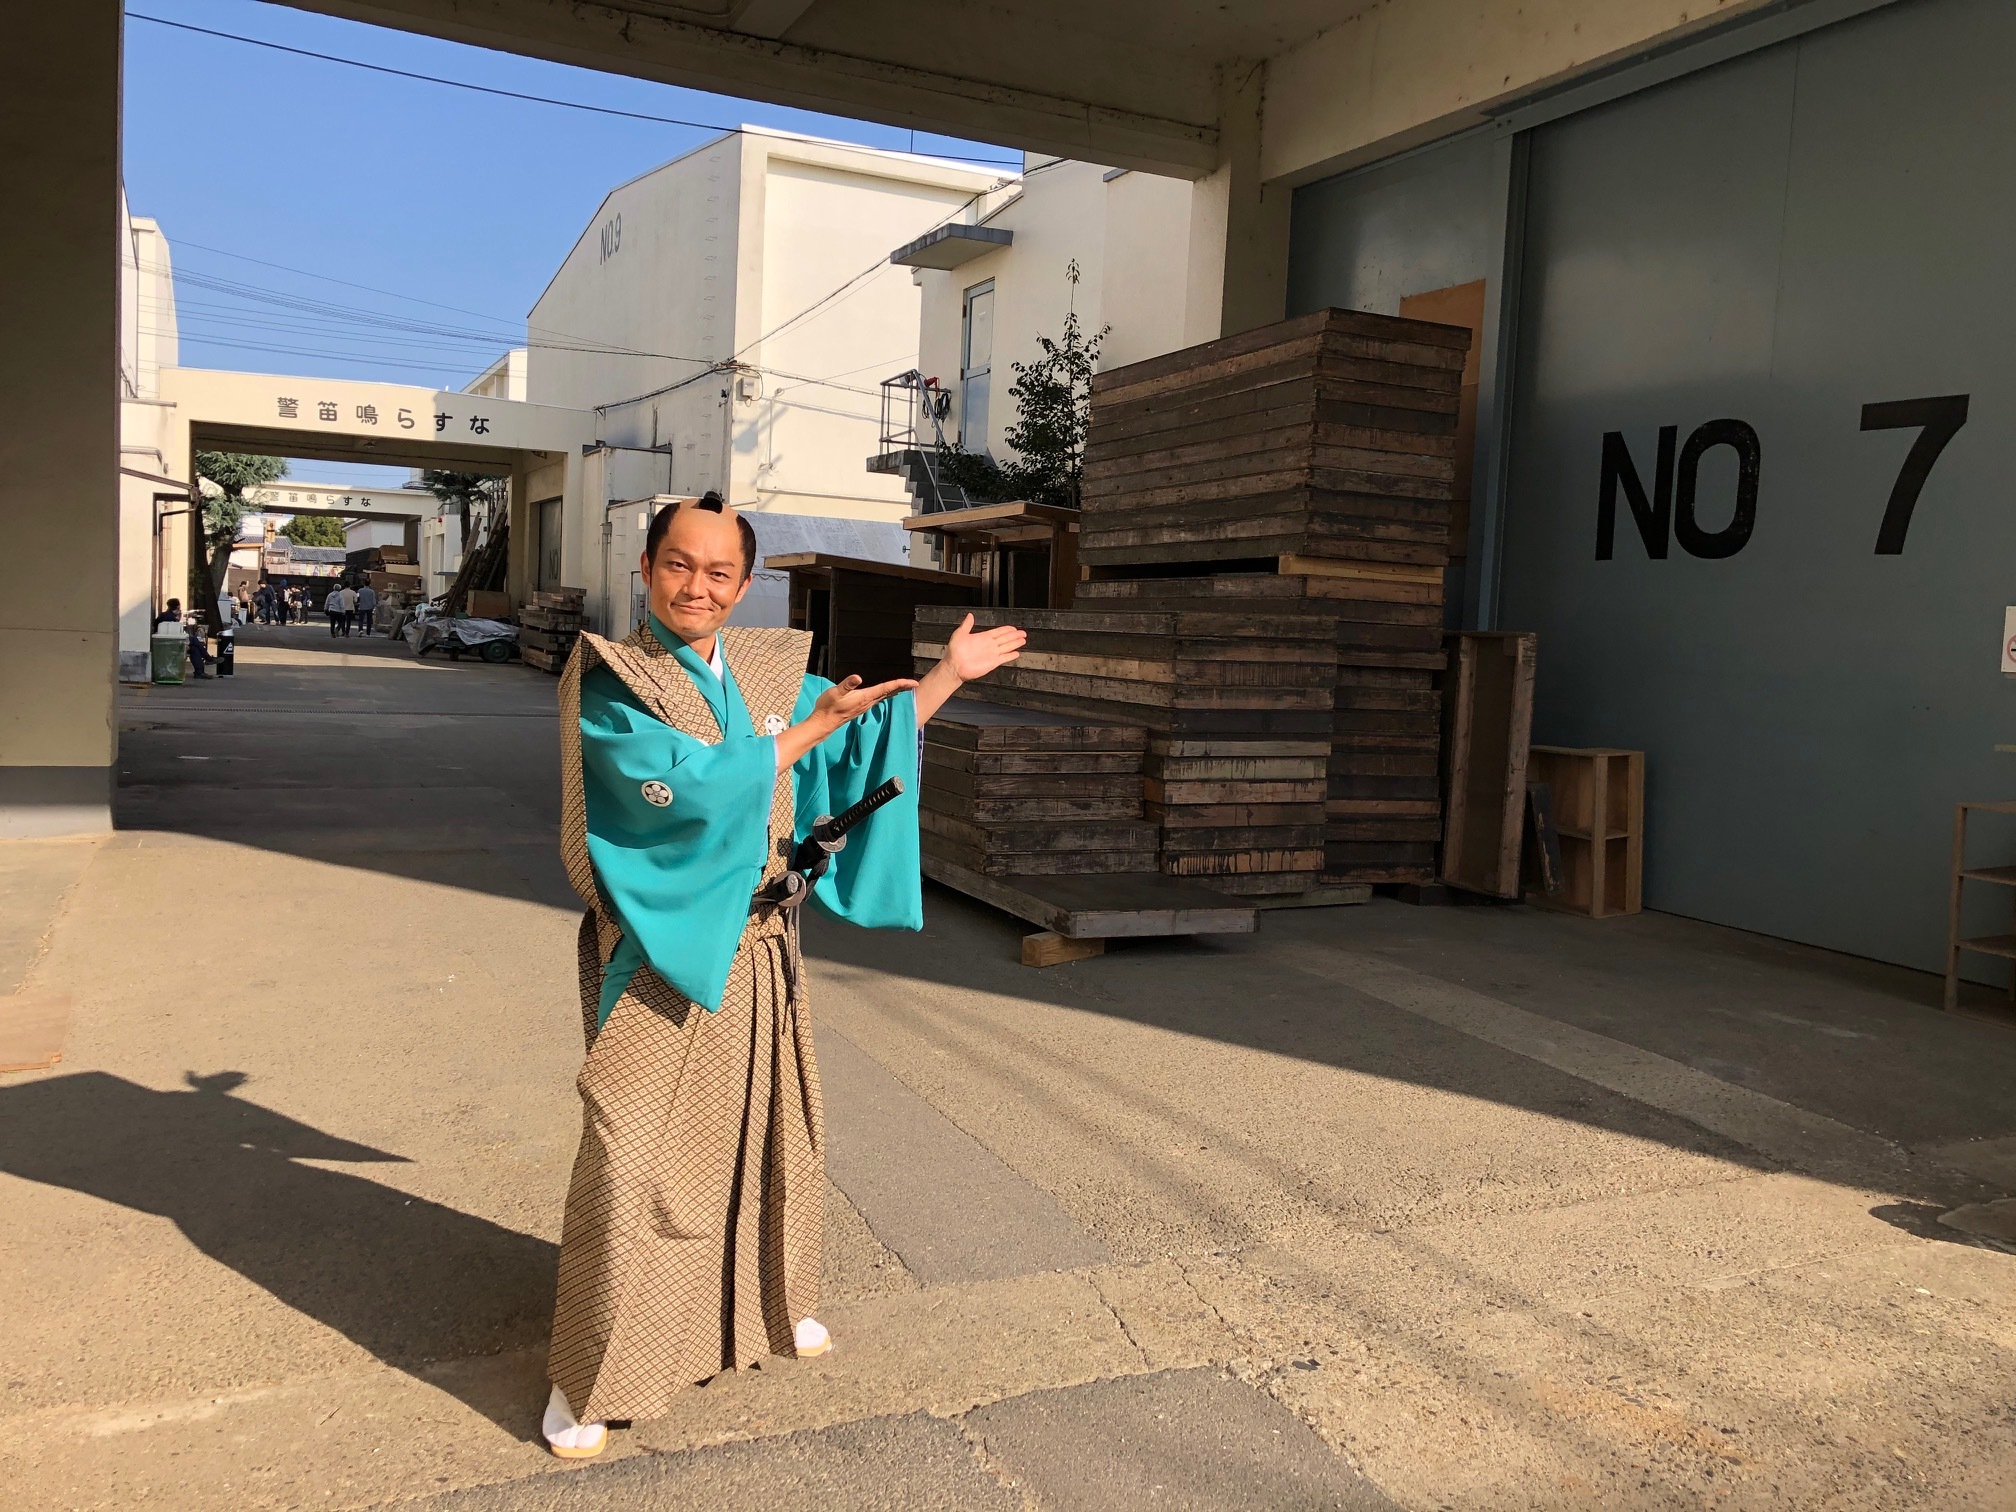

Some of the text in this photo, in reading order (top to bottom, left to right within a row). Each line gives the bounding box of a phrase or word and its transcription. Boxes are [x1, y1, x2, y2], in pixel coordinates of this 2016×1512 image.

[277, 396, 490, 434] 警笛鳴らすな
[1594, 393, 1971, 561] NO 7
